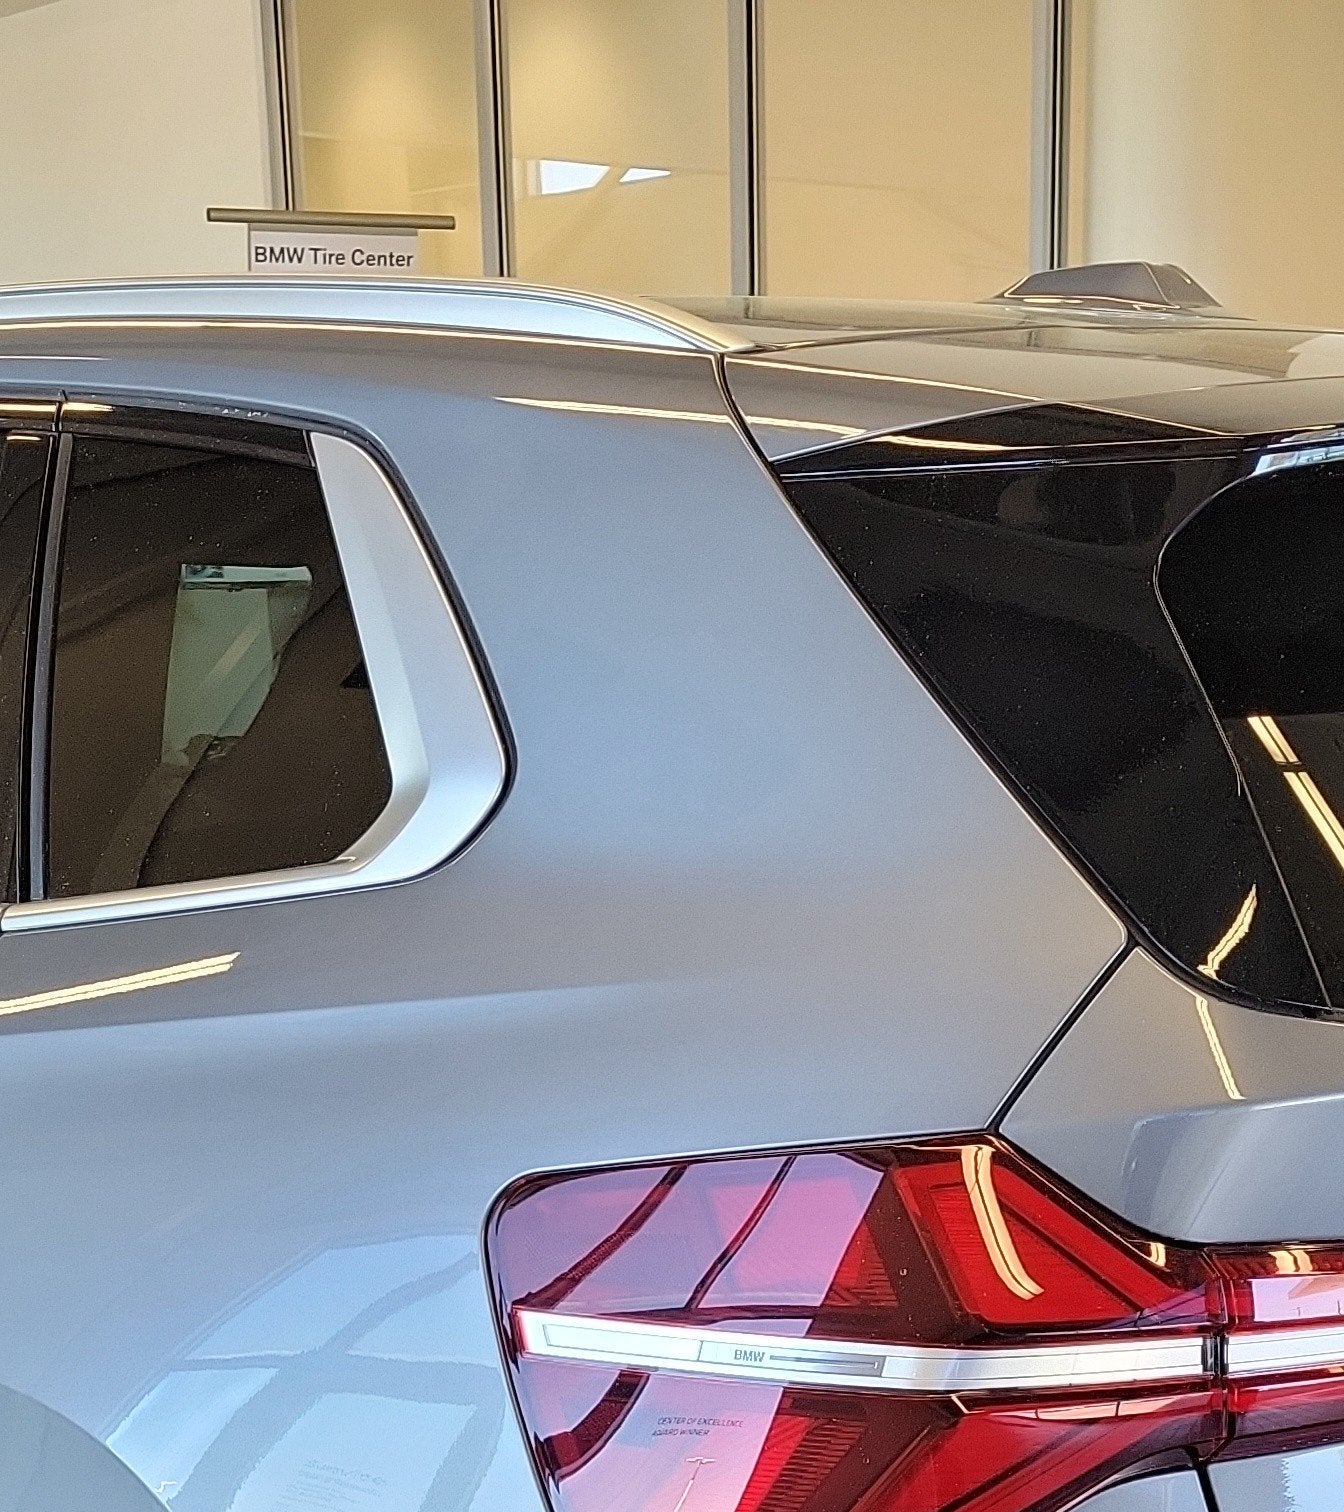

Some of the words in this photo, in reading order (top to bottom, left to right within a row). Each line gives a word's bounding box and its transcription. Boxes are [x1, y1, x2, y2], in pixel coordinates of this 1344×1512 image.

[254, 245, 306, 265] BMW
[309, 247, 346, 266] Tire
[351, 248, 414, 267] Center
[733, 1348, 766, 1363] BMW
